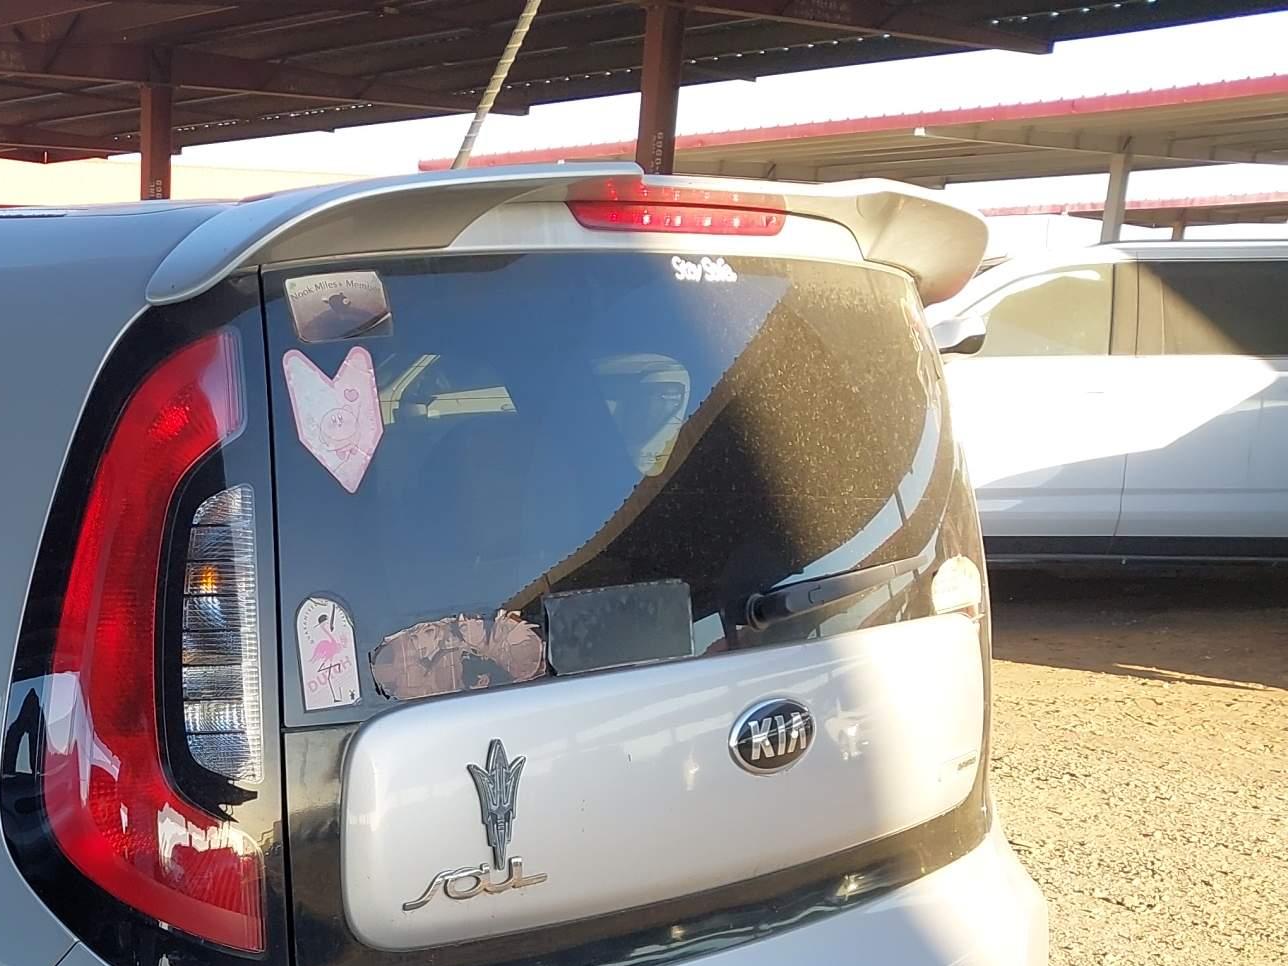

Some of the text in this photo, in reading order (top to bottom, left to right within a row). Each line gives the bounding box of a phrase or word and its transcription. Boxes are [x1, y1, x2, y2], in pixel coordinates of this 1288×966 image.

[290, 286, 314, 300] Nook
[346, 279, 378, 291] Memb
[747, 711, 807, 761] KIA
